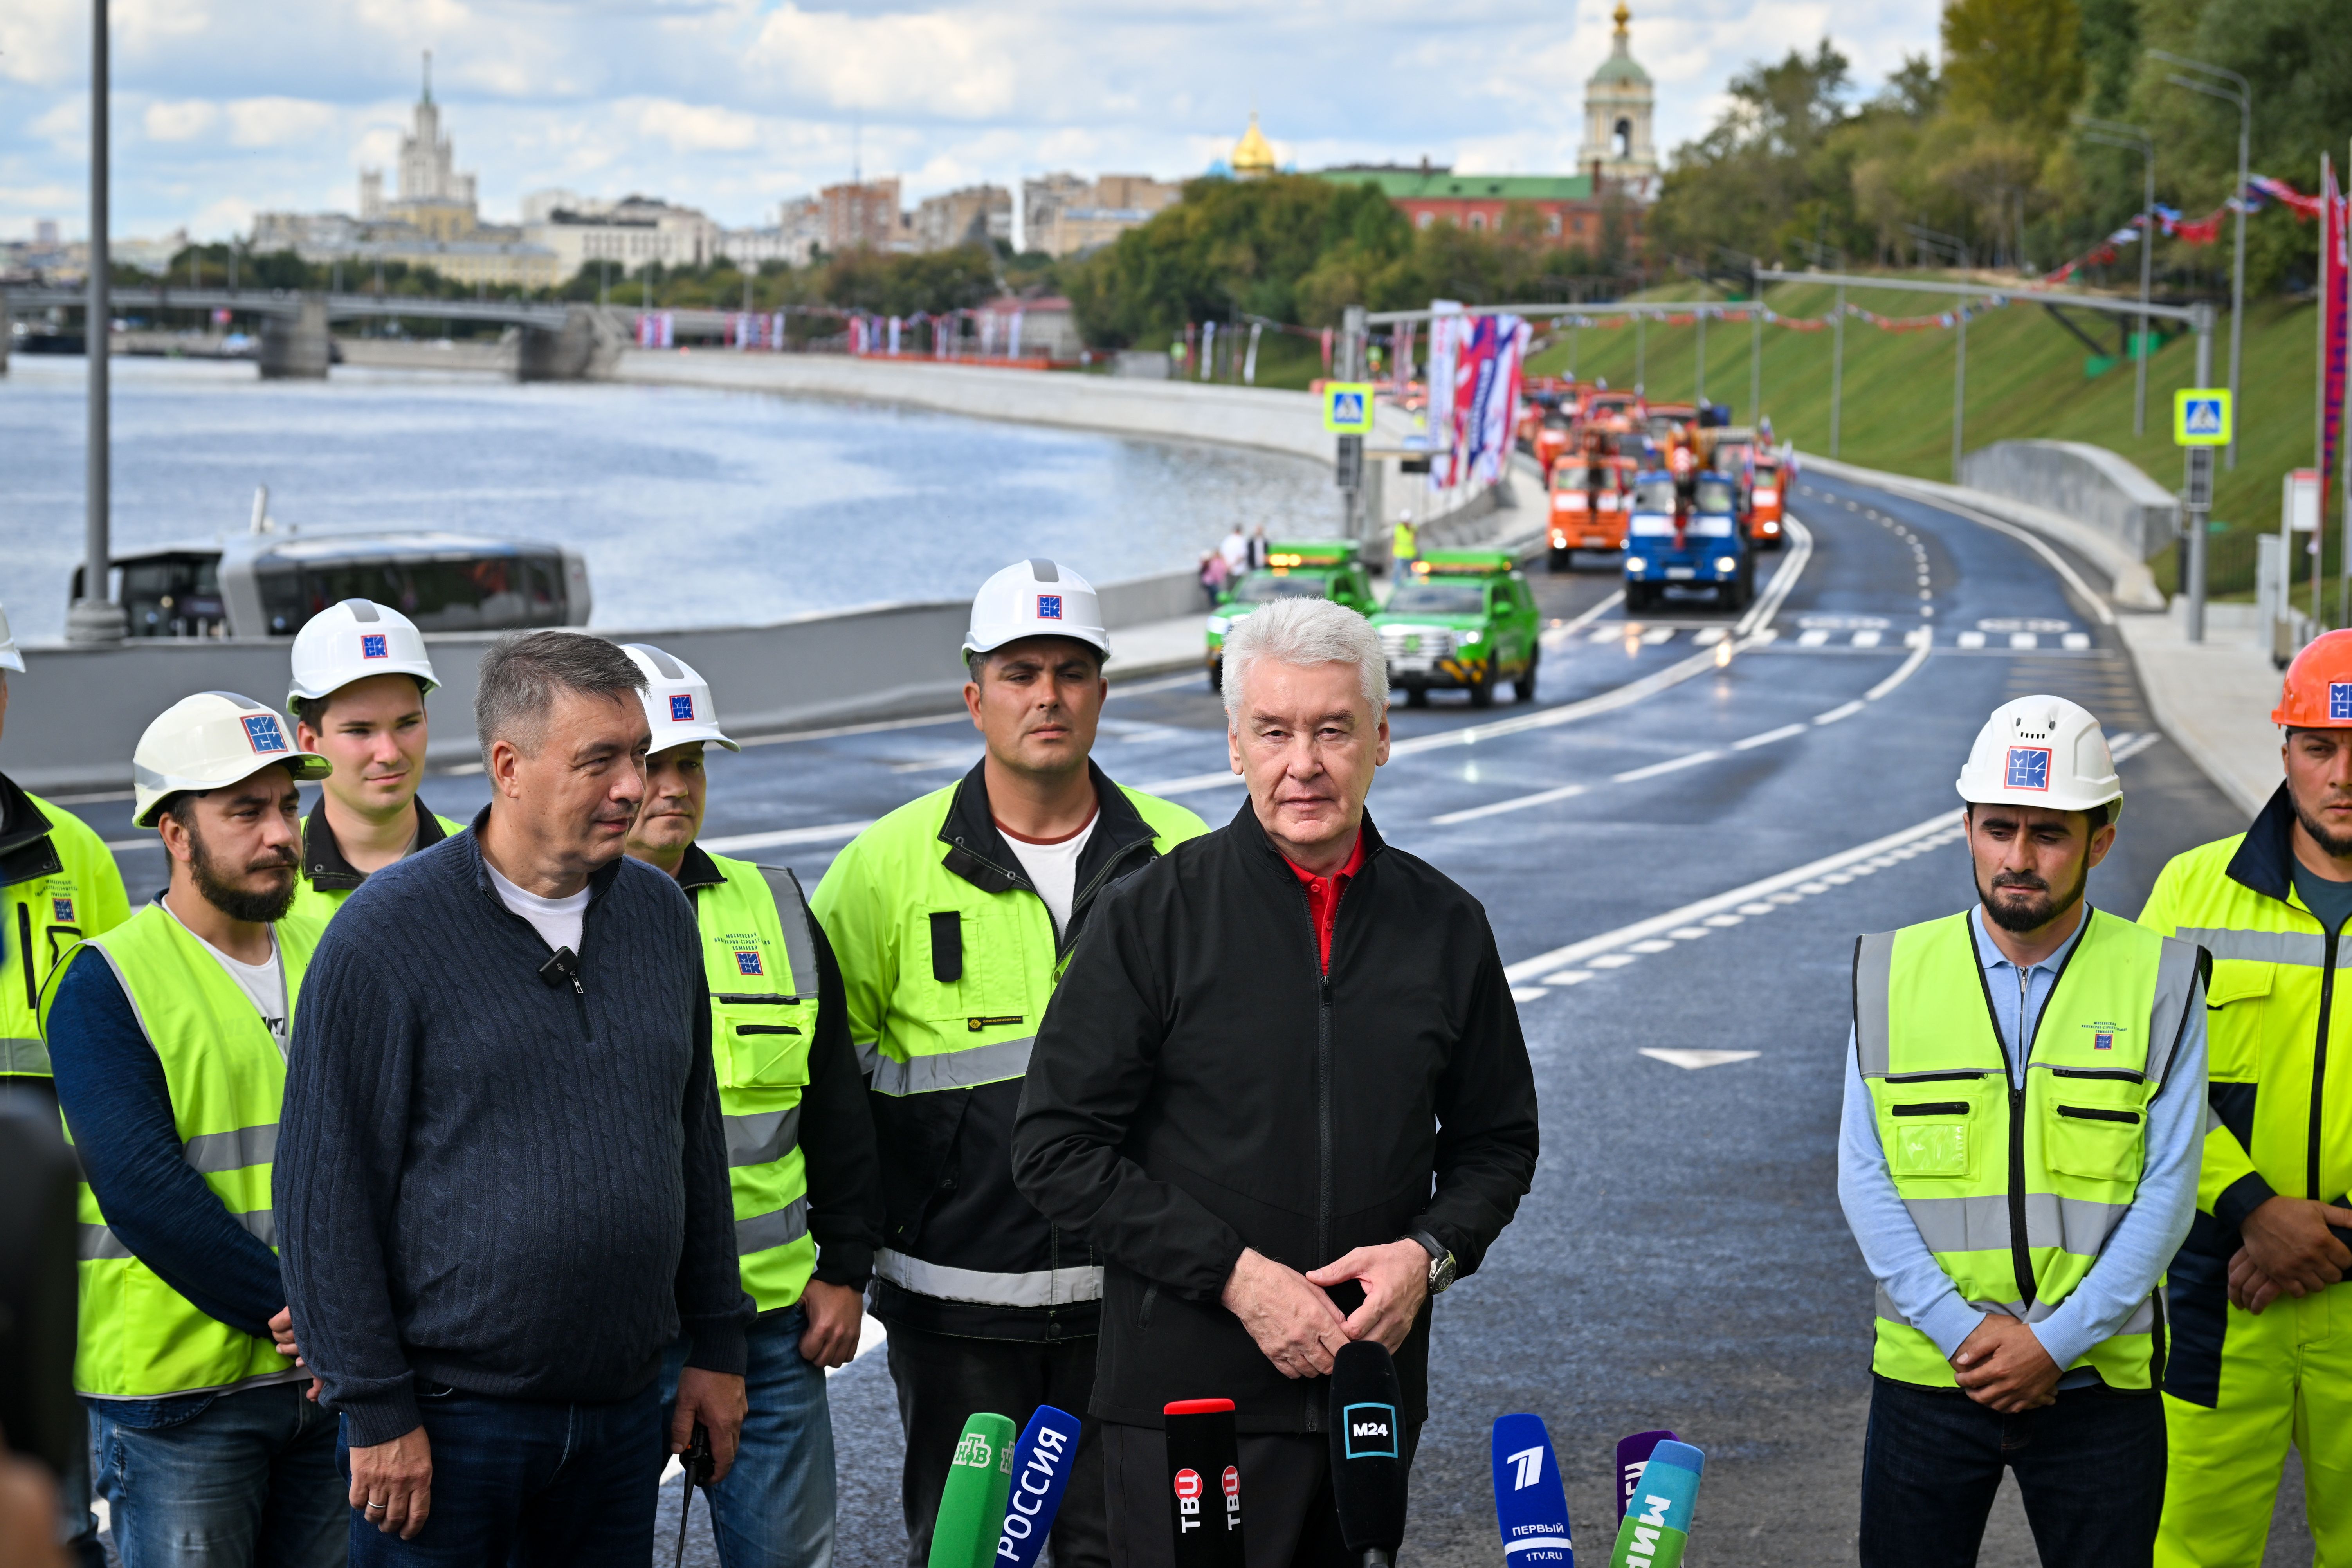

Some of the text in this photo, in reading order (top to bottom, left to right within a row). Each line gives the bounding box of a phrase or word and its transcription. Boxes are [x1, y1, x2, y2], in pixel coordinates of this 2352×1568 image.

[1353, 1422, 1388, 1437] М24
[953, 1433, 991, 1468] НТВ
[997, 1426, 1067, 1561] РОССИЯ
[1178, 1473, 1201, 1533] ТВЦ
[1225, 1471, 1240, 1530] ТВЦ
[1512, 1522, 1564, 1536] ПЕРВЫЙ
[1526, 1551, 1563, 1562] 1TV.RU
